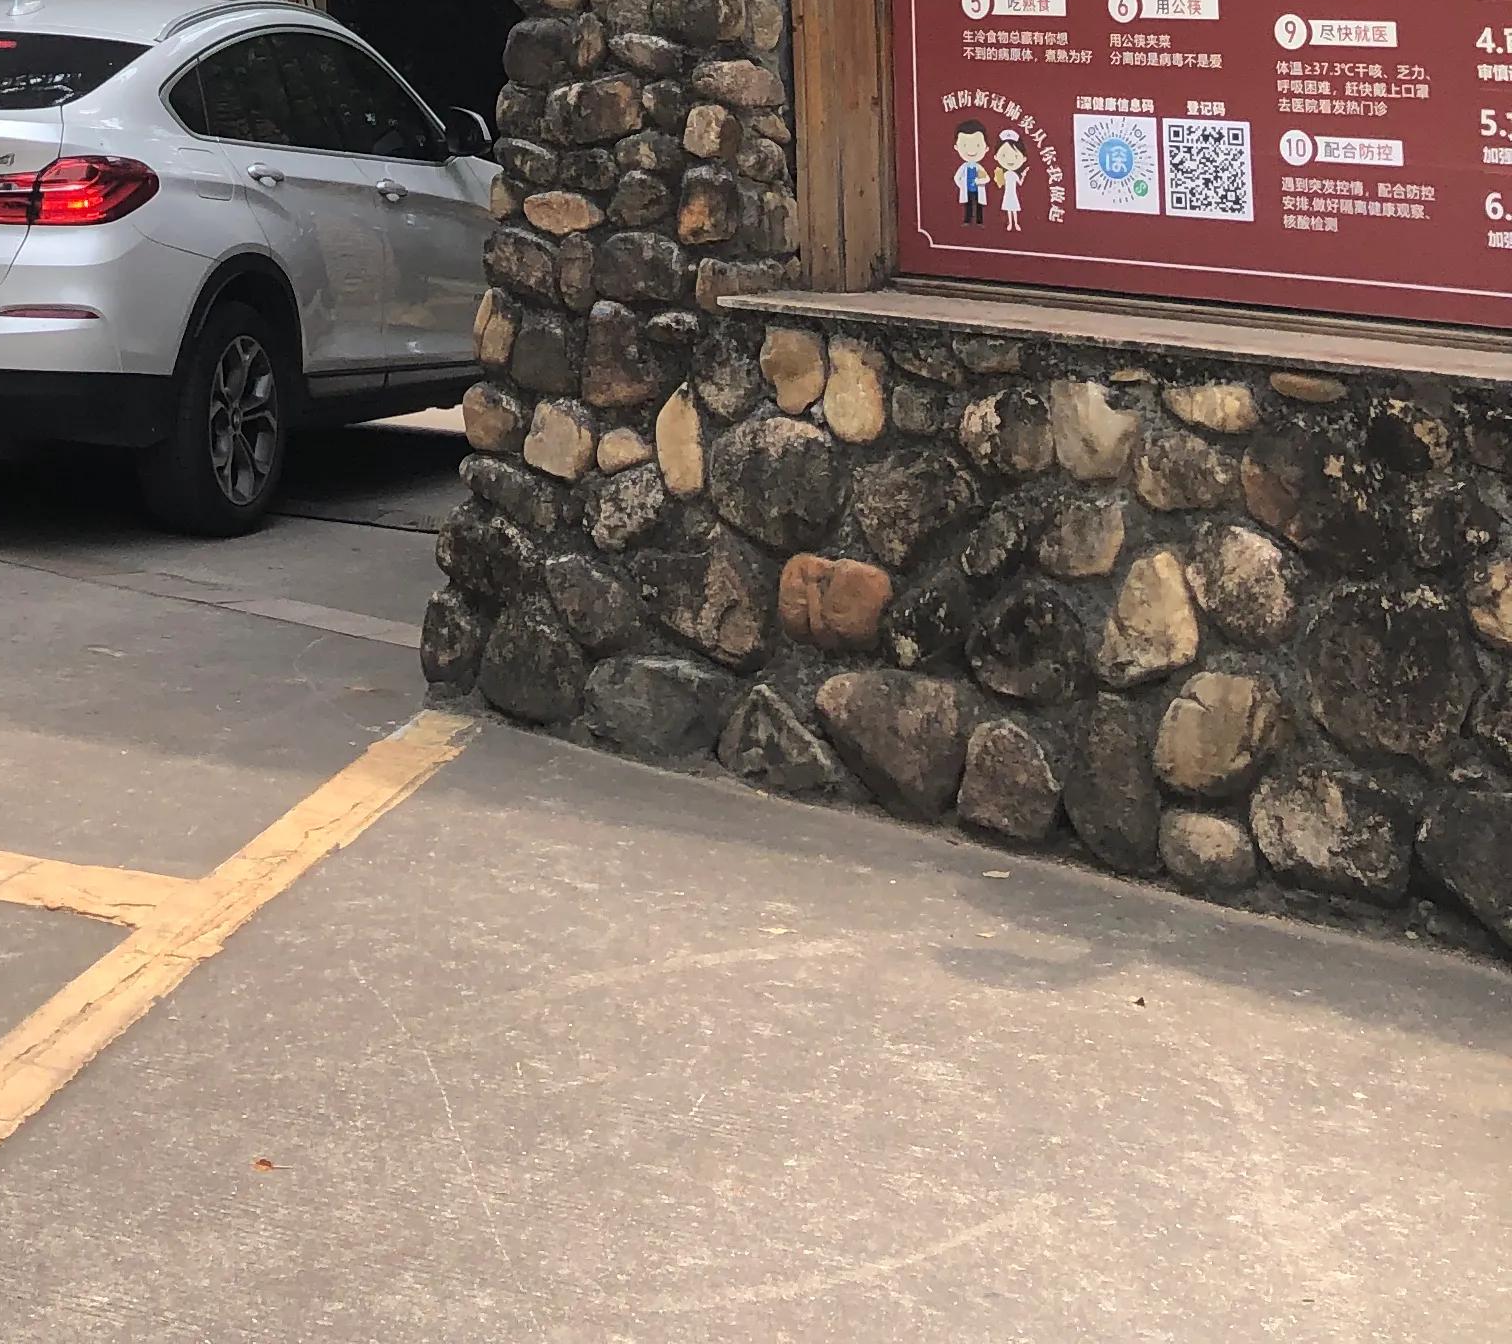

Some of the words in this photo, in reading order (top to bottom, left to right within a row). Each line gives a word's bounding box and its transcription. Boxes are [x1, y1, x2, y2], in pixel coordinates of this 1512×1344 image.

[1156, 0, 1202, 16] 用公筷
[1110, 34, 1171, 48] 用公筷夹菜
[1320, 24, 1388, 43] 尽快就医
[1186, 100, 1226, 116] 登记码
[1278, 98, 1388, 117] 去医院看发热门诊
[1324, 141, 1393, 161] 配合防控
[1283, 214, 1339, 232] 核酸检测
